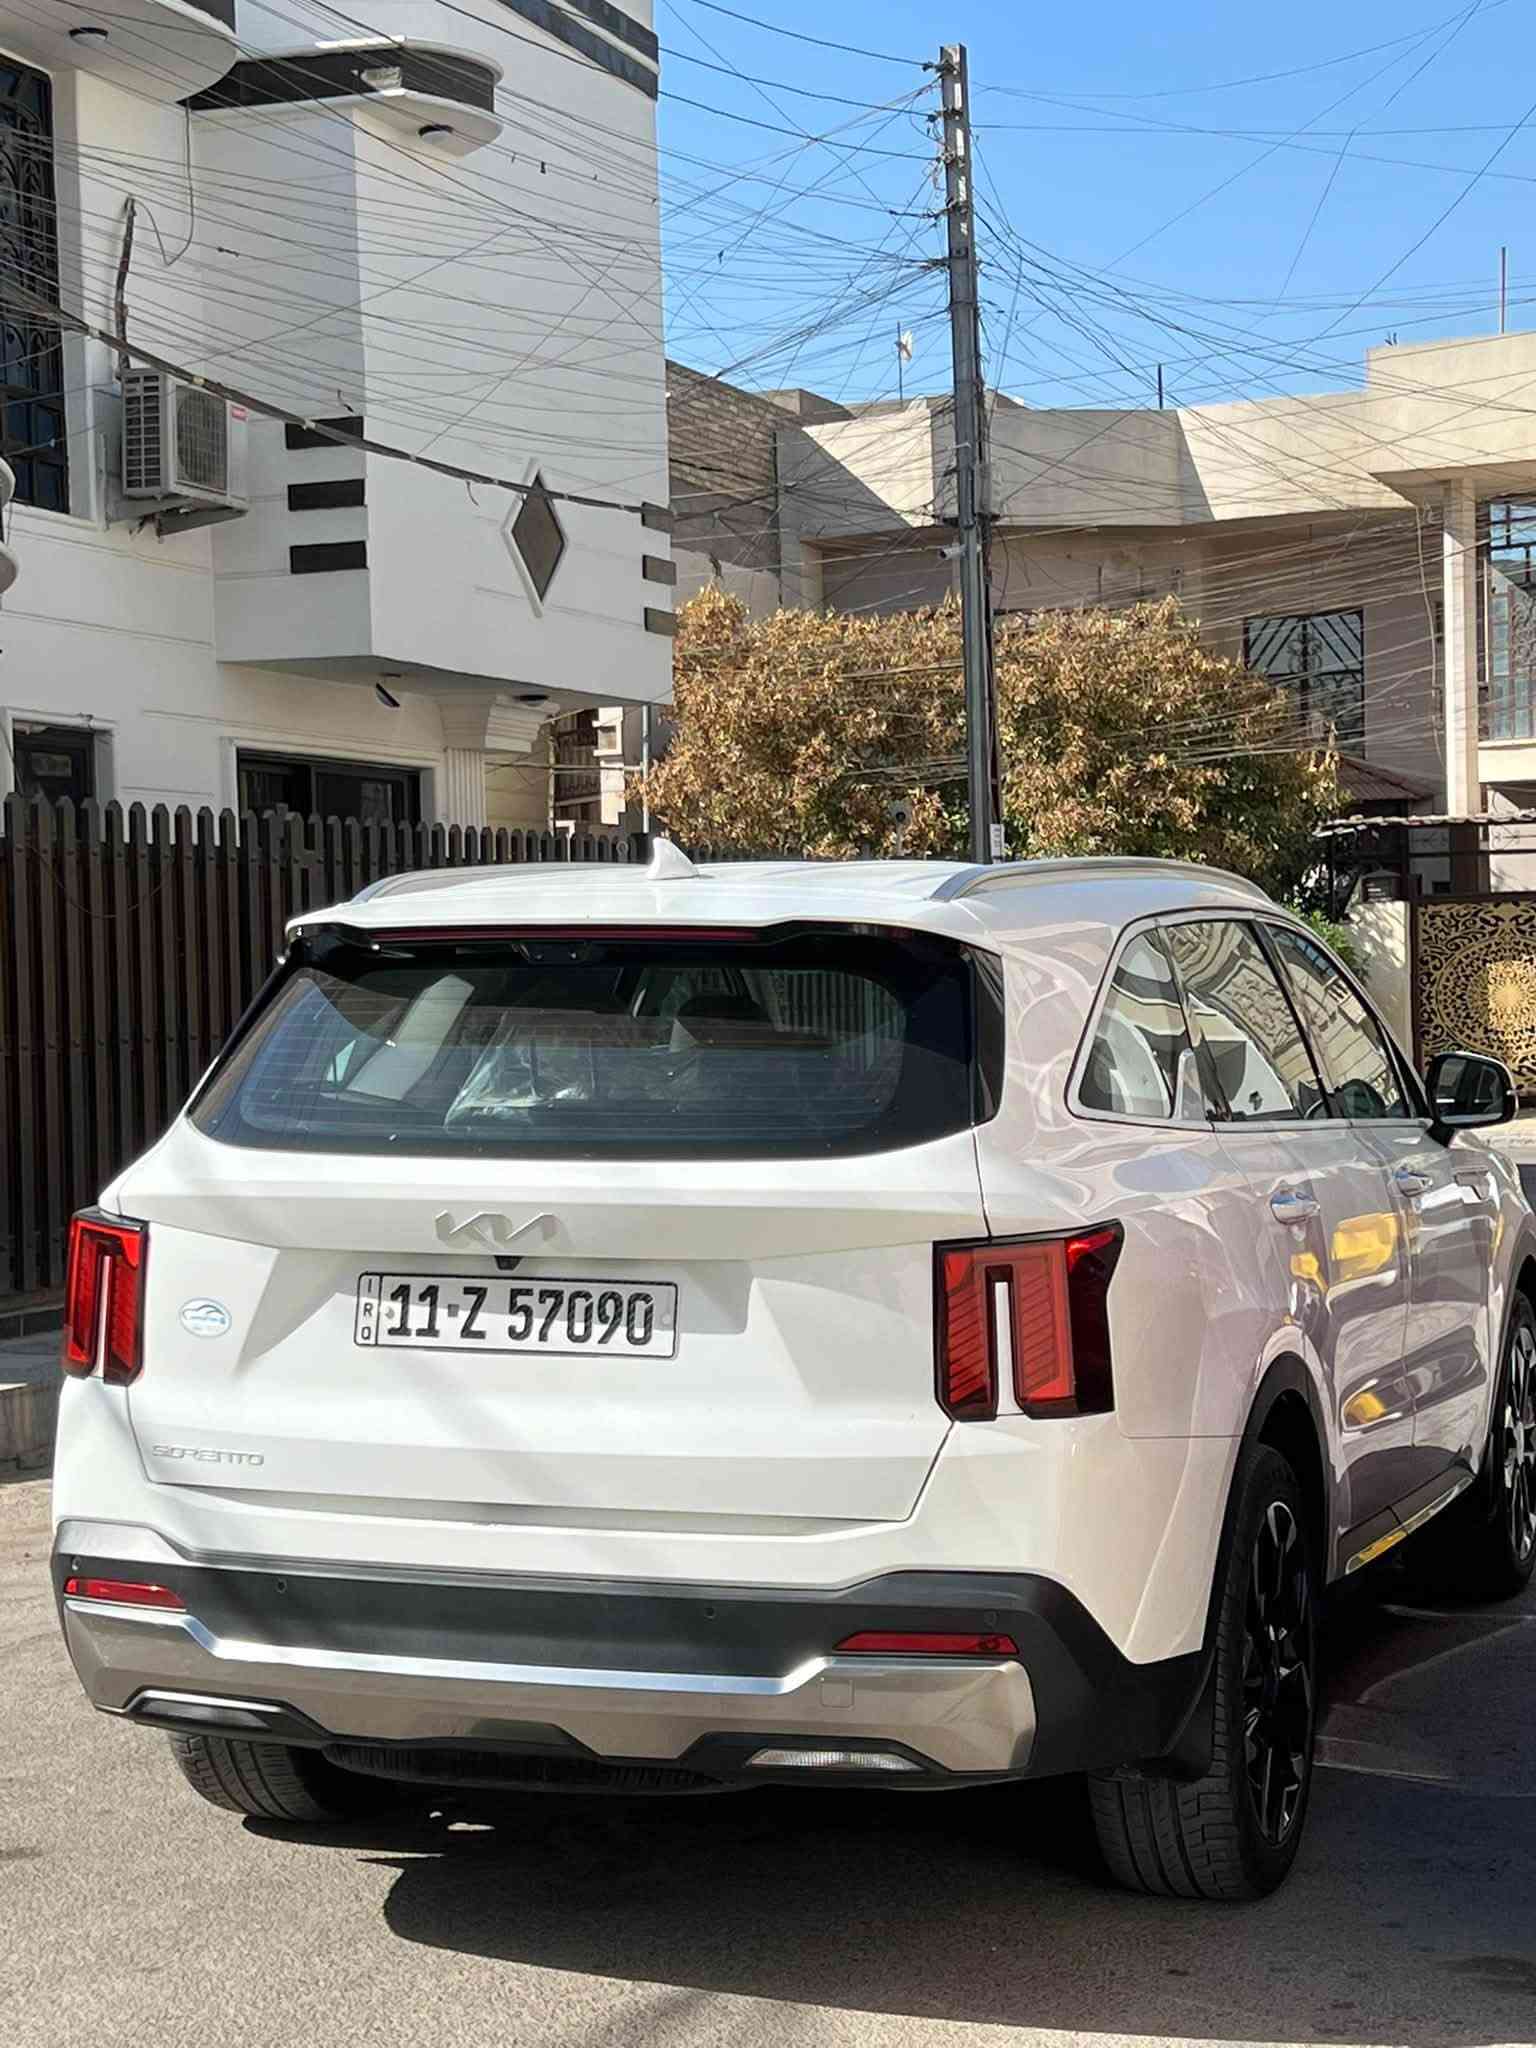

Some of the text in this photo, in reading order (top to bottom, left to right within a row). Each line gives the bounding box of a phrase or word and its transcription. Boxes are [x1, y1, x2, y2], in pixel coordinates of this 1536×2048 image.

[388, 1284, 654, 1345] 11 Z 57090
[152, 1445, 264, 1466] SORENTO
